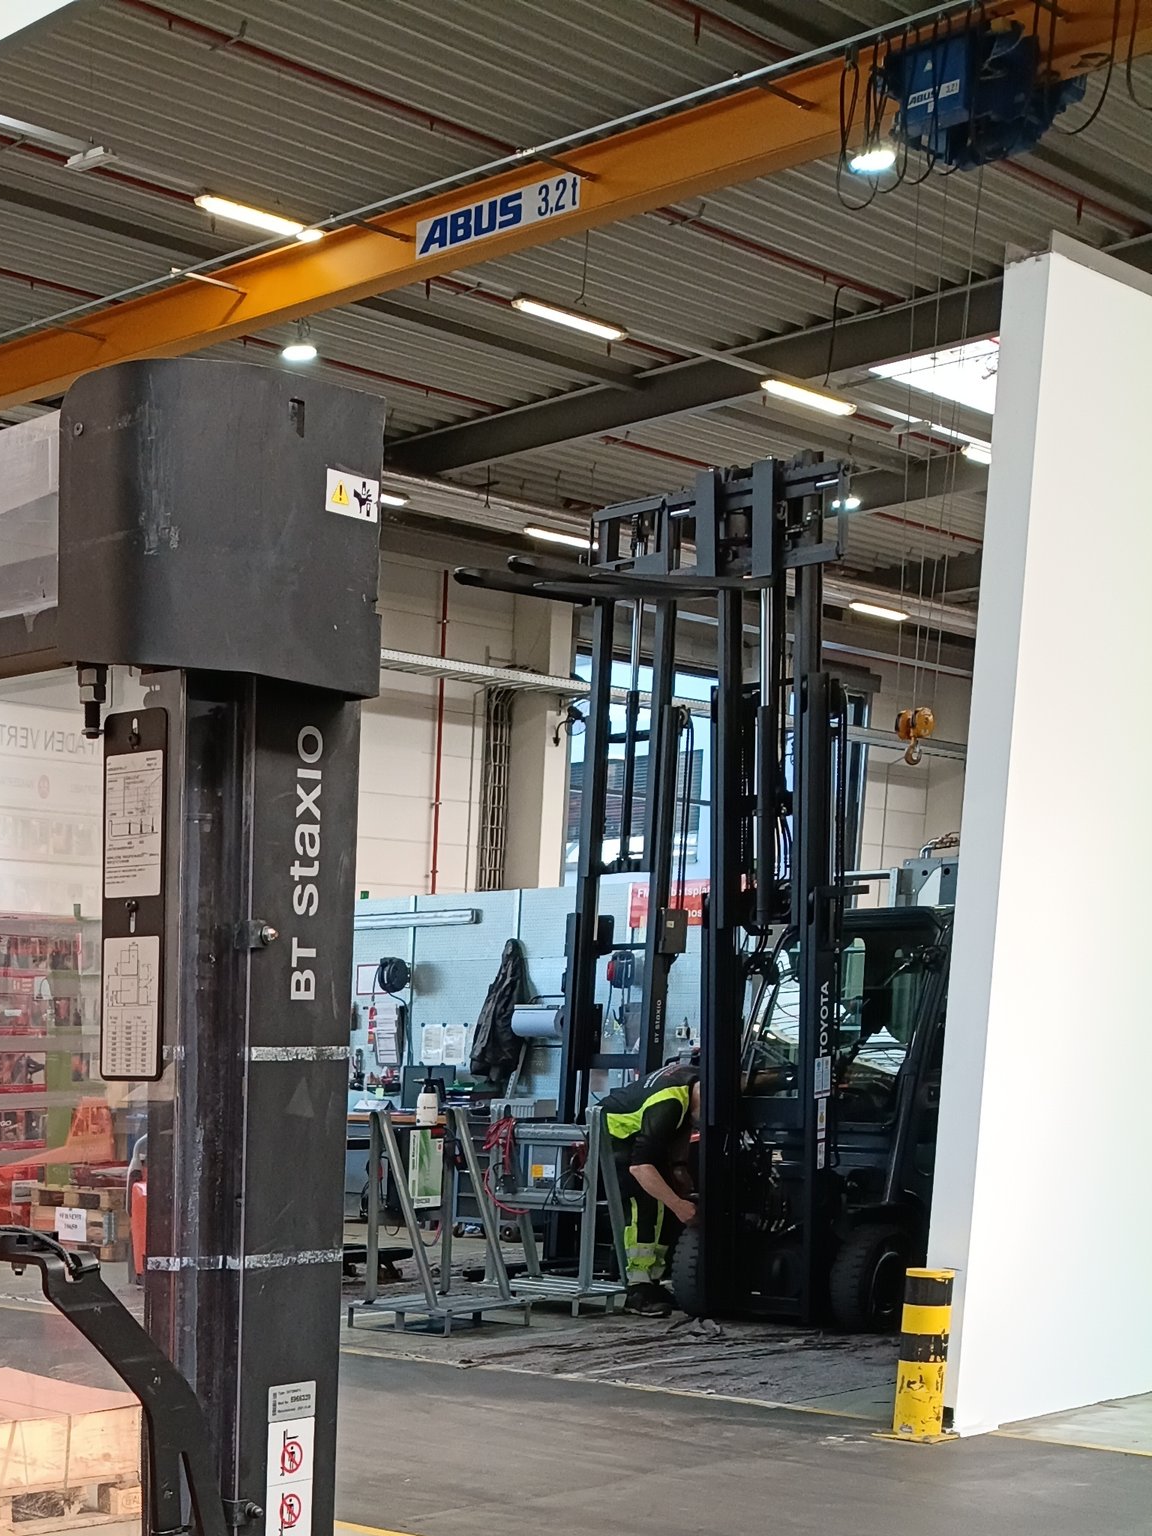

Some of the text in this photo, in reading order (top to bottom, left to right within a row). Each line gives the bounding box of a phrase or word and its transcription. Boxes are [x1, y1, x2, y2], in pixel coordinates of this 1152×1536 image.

[419, 176, 578, 255] ABUS 3,2 t
[290, 937, 317, 1001] BT
[819, 980, 830, 1057] TOYOTA
